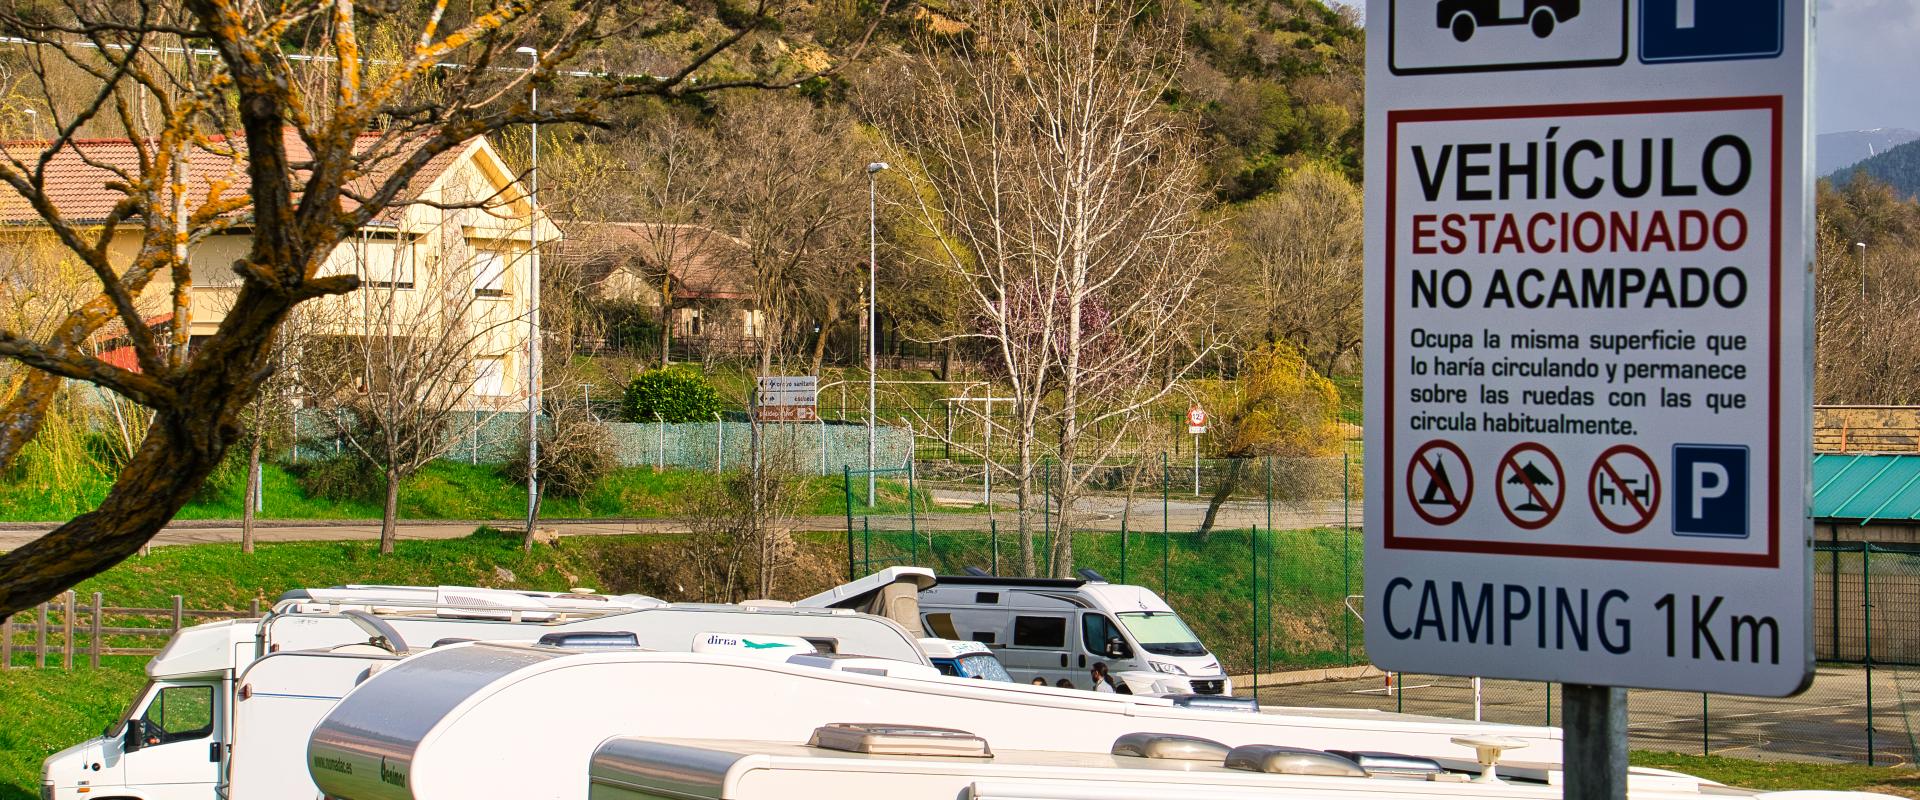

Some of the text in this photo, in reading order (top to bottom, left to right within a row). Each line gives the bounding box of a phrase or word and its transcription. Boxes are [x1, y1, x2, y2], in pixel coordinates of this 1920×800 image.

[1411, 126, 1752, 202] VEHÍCULO
[1412, 208, 1748, 255] ESTACIONADO
[1411, 266, 1748, 309] NO ACAMPADO
[1410, 328, 1747, 356] Ocupa la misma superficie que
[1411, 356, 1747, 384] lo haría circulando y permanece
[1410, 383, 1747, 414] sobre las ruedas con las que
[1410, 411, 1638, 435] circula habitualmente.
[1692, 462, 1729, 519] P
[1382, 576, 1632, 655] CAMPING
